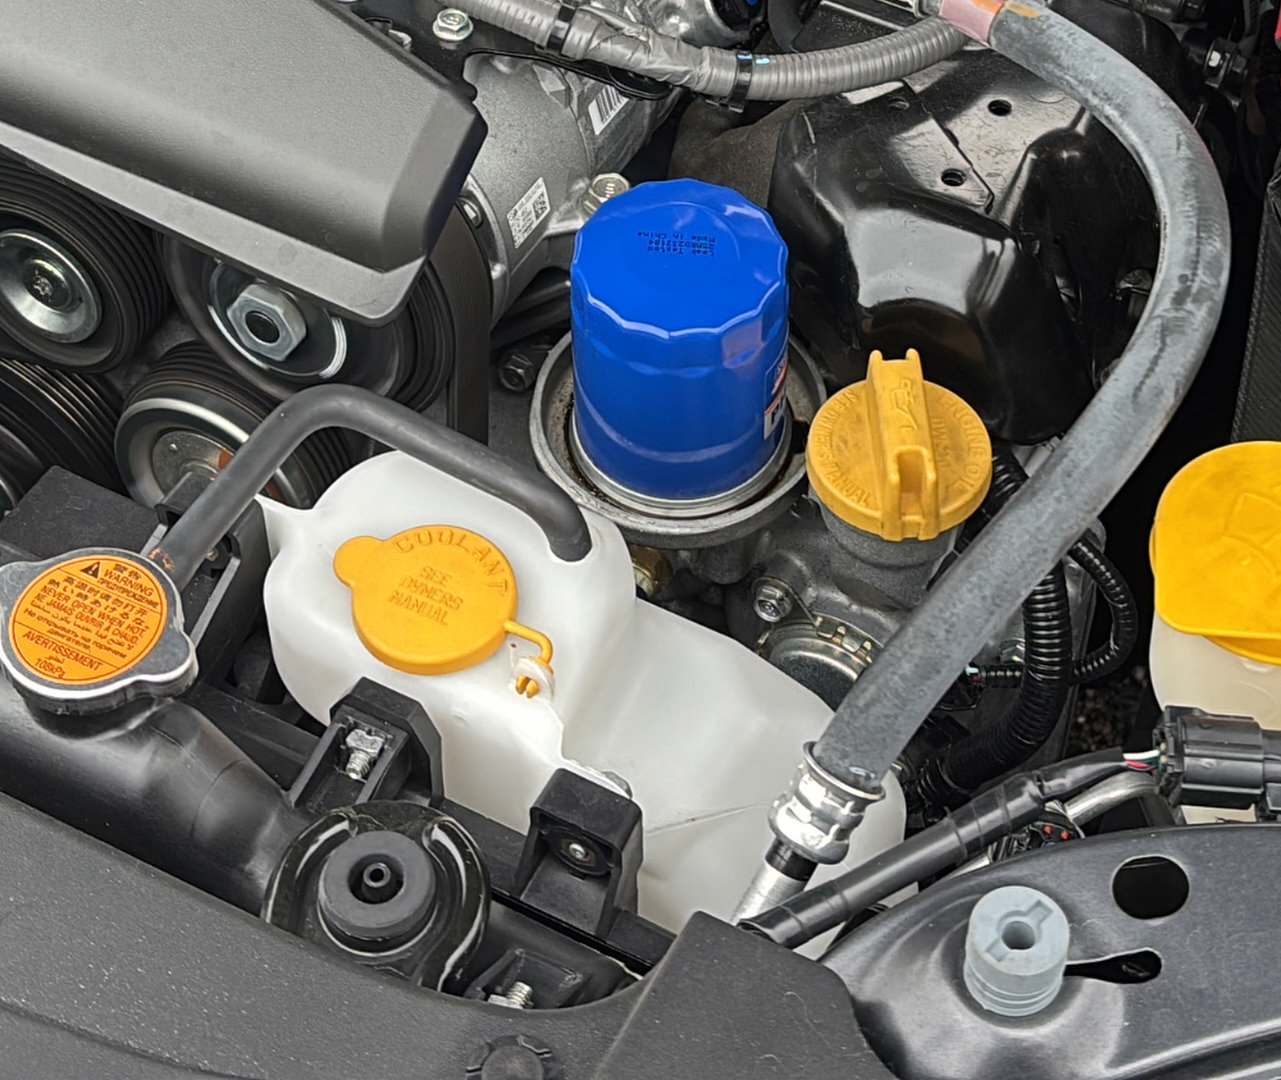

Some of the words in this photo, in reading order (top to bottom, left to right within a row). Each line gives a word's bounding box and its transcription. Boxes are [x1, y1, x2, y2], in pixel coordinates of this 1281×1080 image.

[637, 232, 667, 240] China
[647, 246, 683, 255] Tested
[937, 392, 986, 457] ENGINE
[820, 461, 871, 508] MANUAL
[946, 463, 982, 495] OIL
[395, 529, 509, 596] COOLANT
[420, 565, 452, 587] SEE
[102, 568, 155, 596] WARNING
[22, 607, 37, 617] Не
[33, 592, 47, 602] NE
[45, 598, 76, 616] JAMAIS
[73, 611, 105, 629] OUVRIR
[39, 585, 71, 603] NEVER
[70, 599, 97, 615] OPEN
[95, 610, 125, 627] WHEN
[124, 623, 147, 637] HOT.
[388, 591, 448, 626] MANUAL
[21, 629, 103, 671] AVERTISSEMENT
[32, 657, 68, 678] 108kPa
